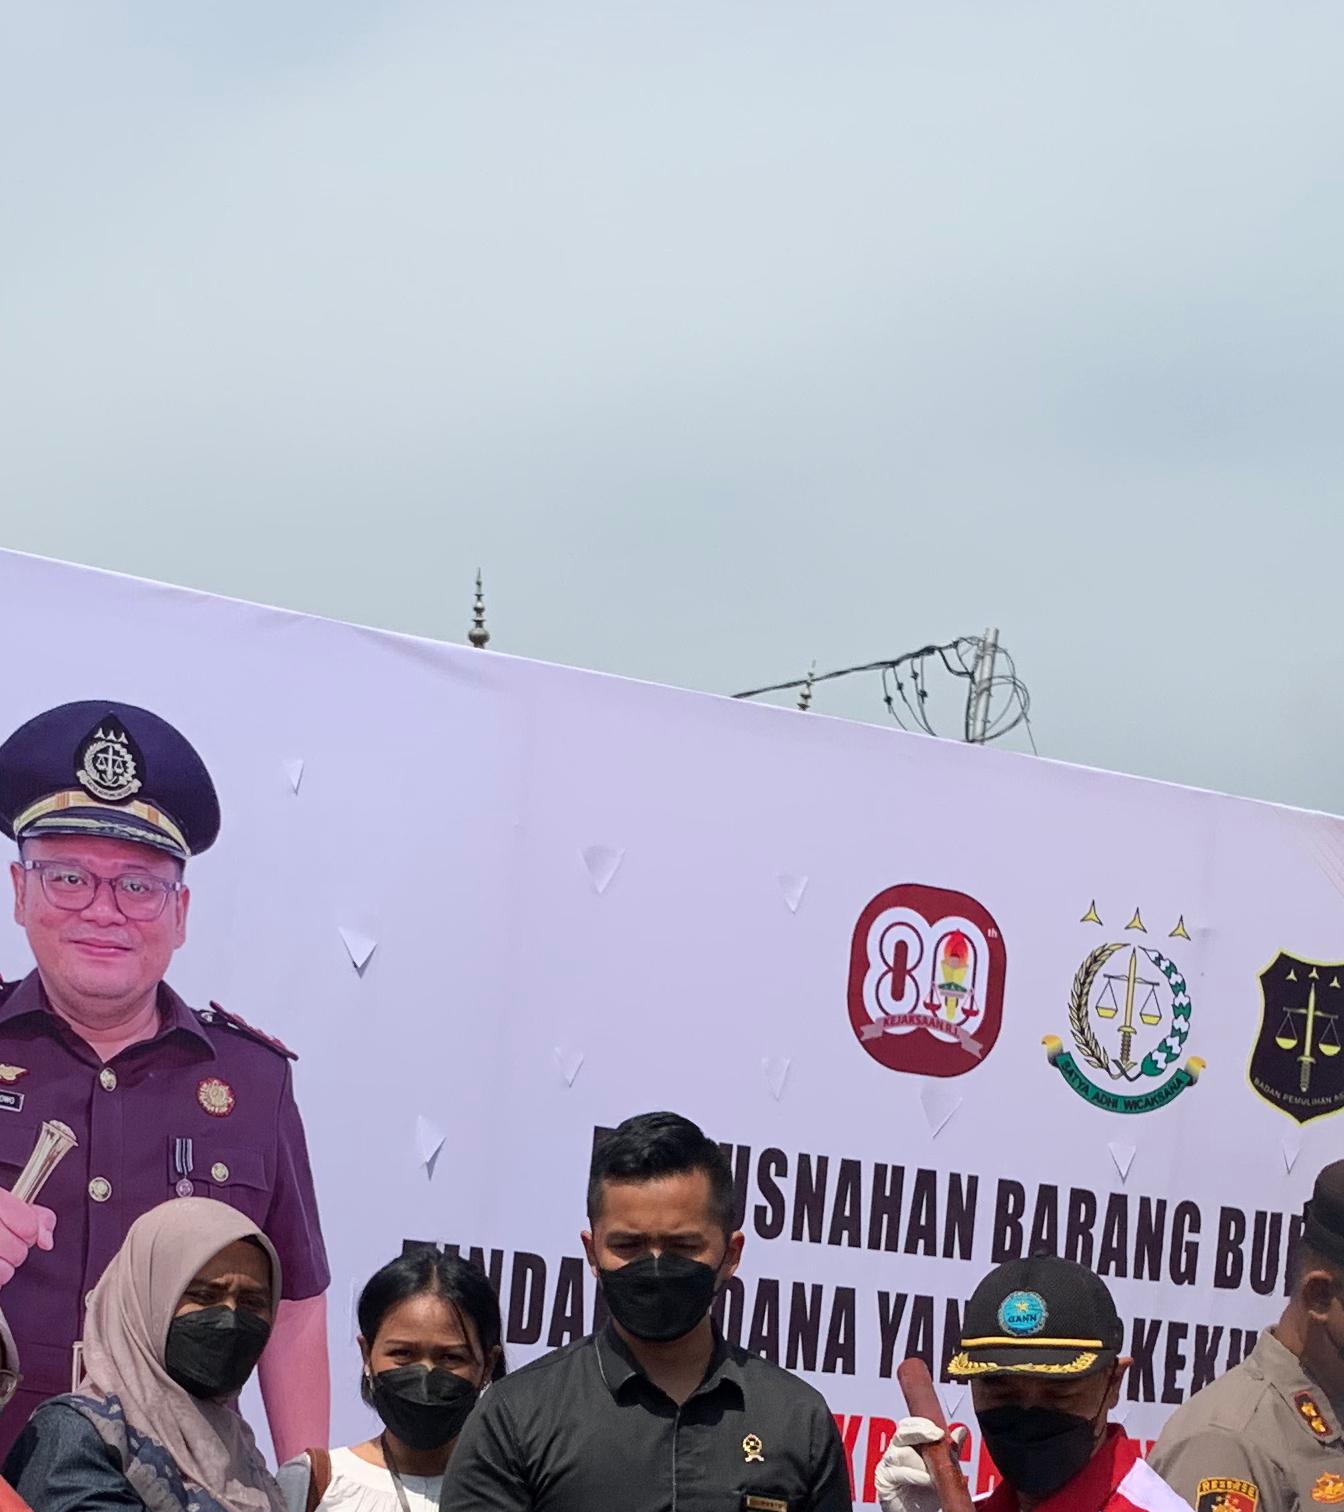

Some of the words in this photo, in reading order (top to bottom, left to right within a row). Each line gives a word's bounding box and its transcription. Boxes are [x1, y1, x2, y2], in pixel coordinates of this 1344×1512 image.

[863, 907, 989, 1040] 80
[883, 1014, 944, 1031] KEJAKSAAN
[1061, 1060, 1090, 1094] SATYA
[1093, 1092, 1118, 1109] ADHI
[990, 1179, 1200, 1287] BARANG
